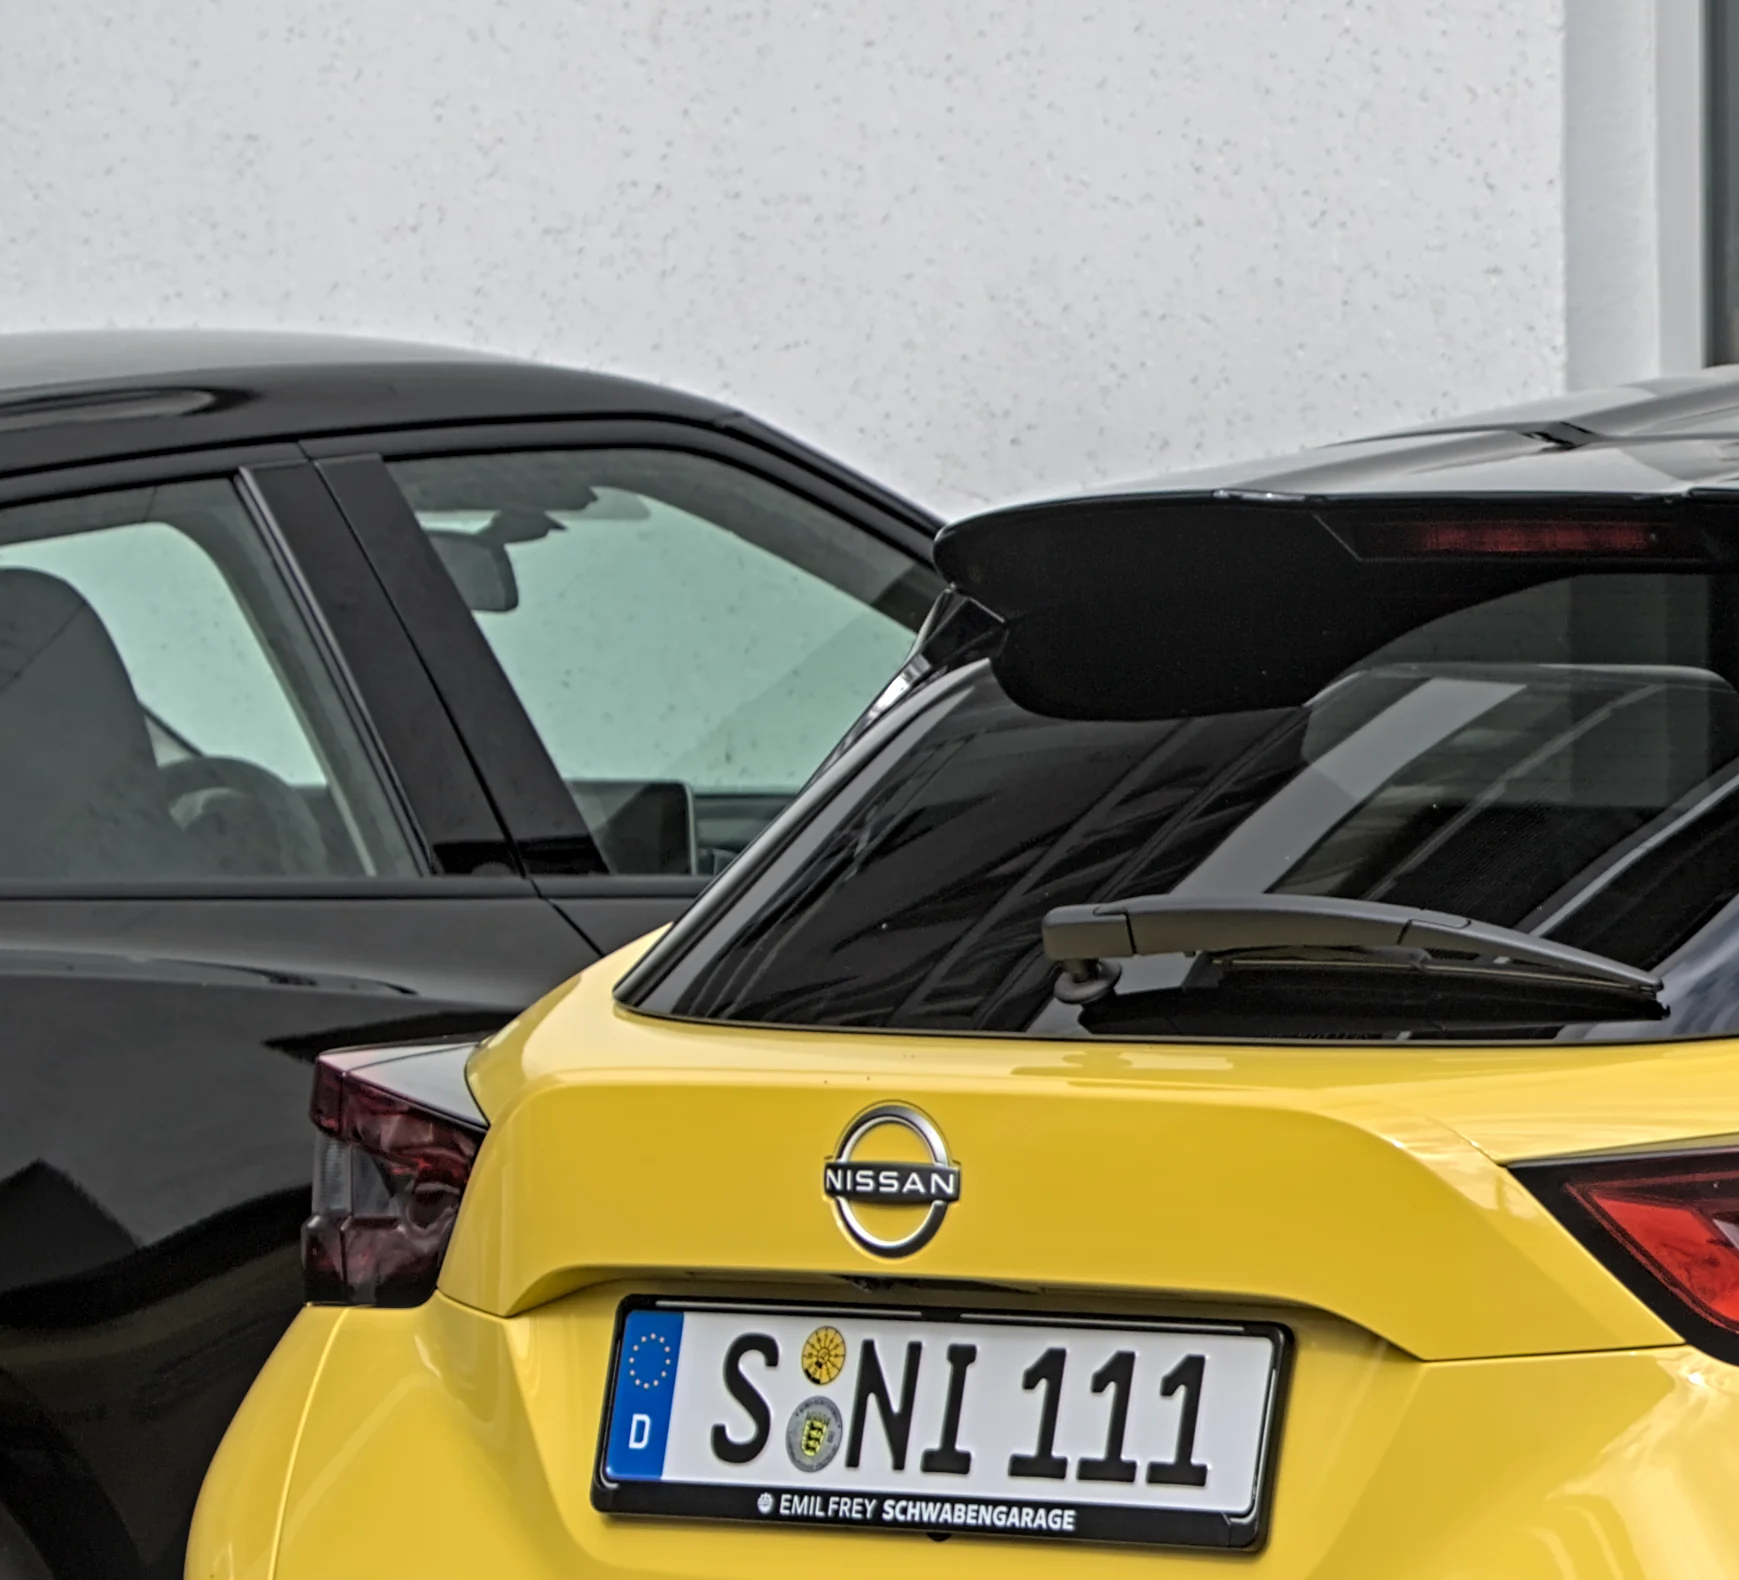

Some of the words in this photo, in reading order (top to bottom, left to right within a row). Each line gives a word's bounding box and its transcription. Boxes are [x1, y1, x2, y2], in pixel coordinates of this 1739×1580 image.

[826, 1168, 954, 1195] NISSAN
[710, 1332, 780, 1464] S
[845, 1338, 978, 1475] NI
[1007, 1347, 1208, 1487] 111
[628, 1413, 651, 1449] D
[778, 1494, 824, 1518] EMIL
[827, 1496, 878, 1520] FREY
[881, 1499, 1077, 1531] SCHWABENGARAGE
